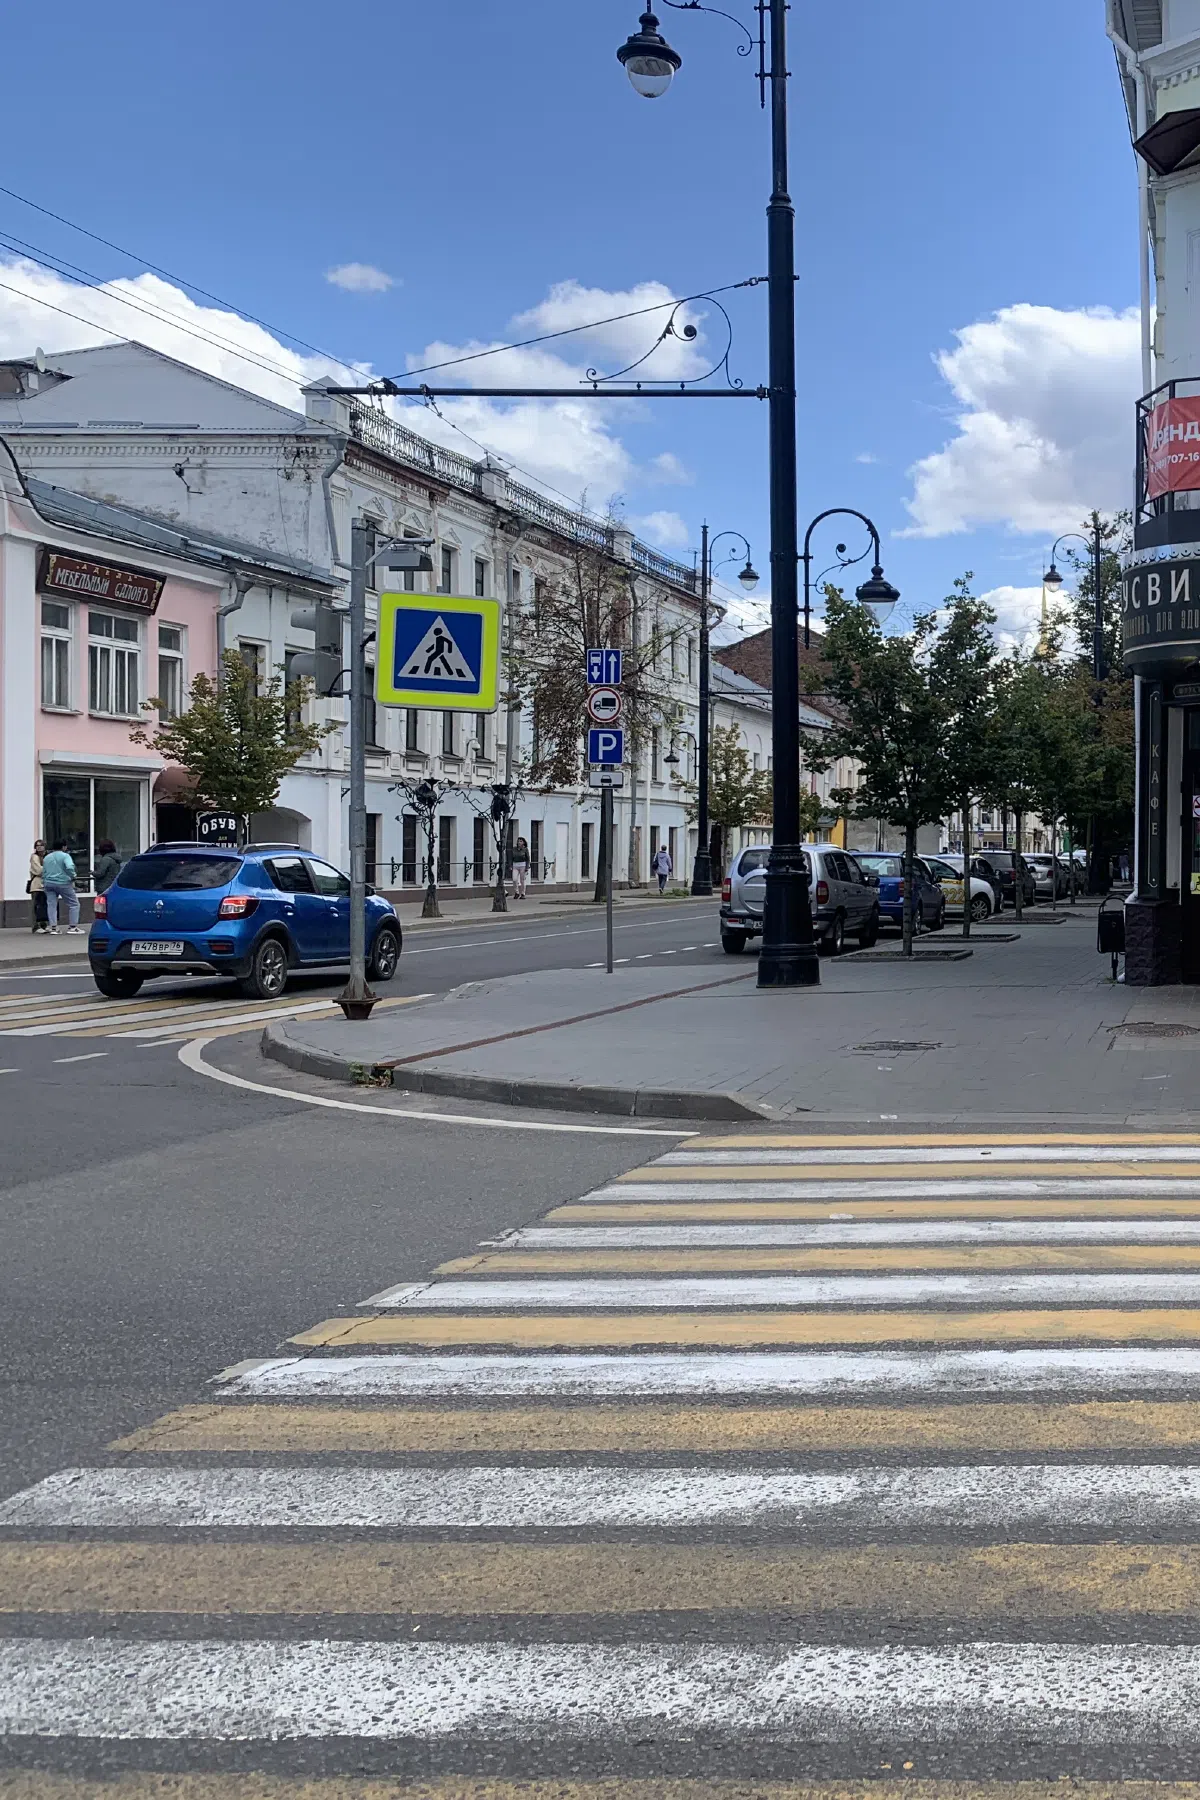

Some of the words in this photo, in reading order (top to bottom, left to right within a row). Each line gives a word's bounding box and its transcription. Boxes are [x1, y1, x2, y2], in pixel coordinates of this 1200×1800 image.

[55, 567, 110, 595] МЕБЕЛЬНЫЙ
[114, 582, 149, 604] САЛОНЪ
[1156, 611, 1173, 633] ДЛЯ
[598, 733, 617, 760] P
[1150, 744, 1159, 836] КАФЕ
